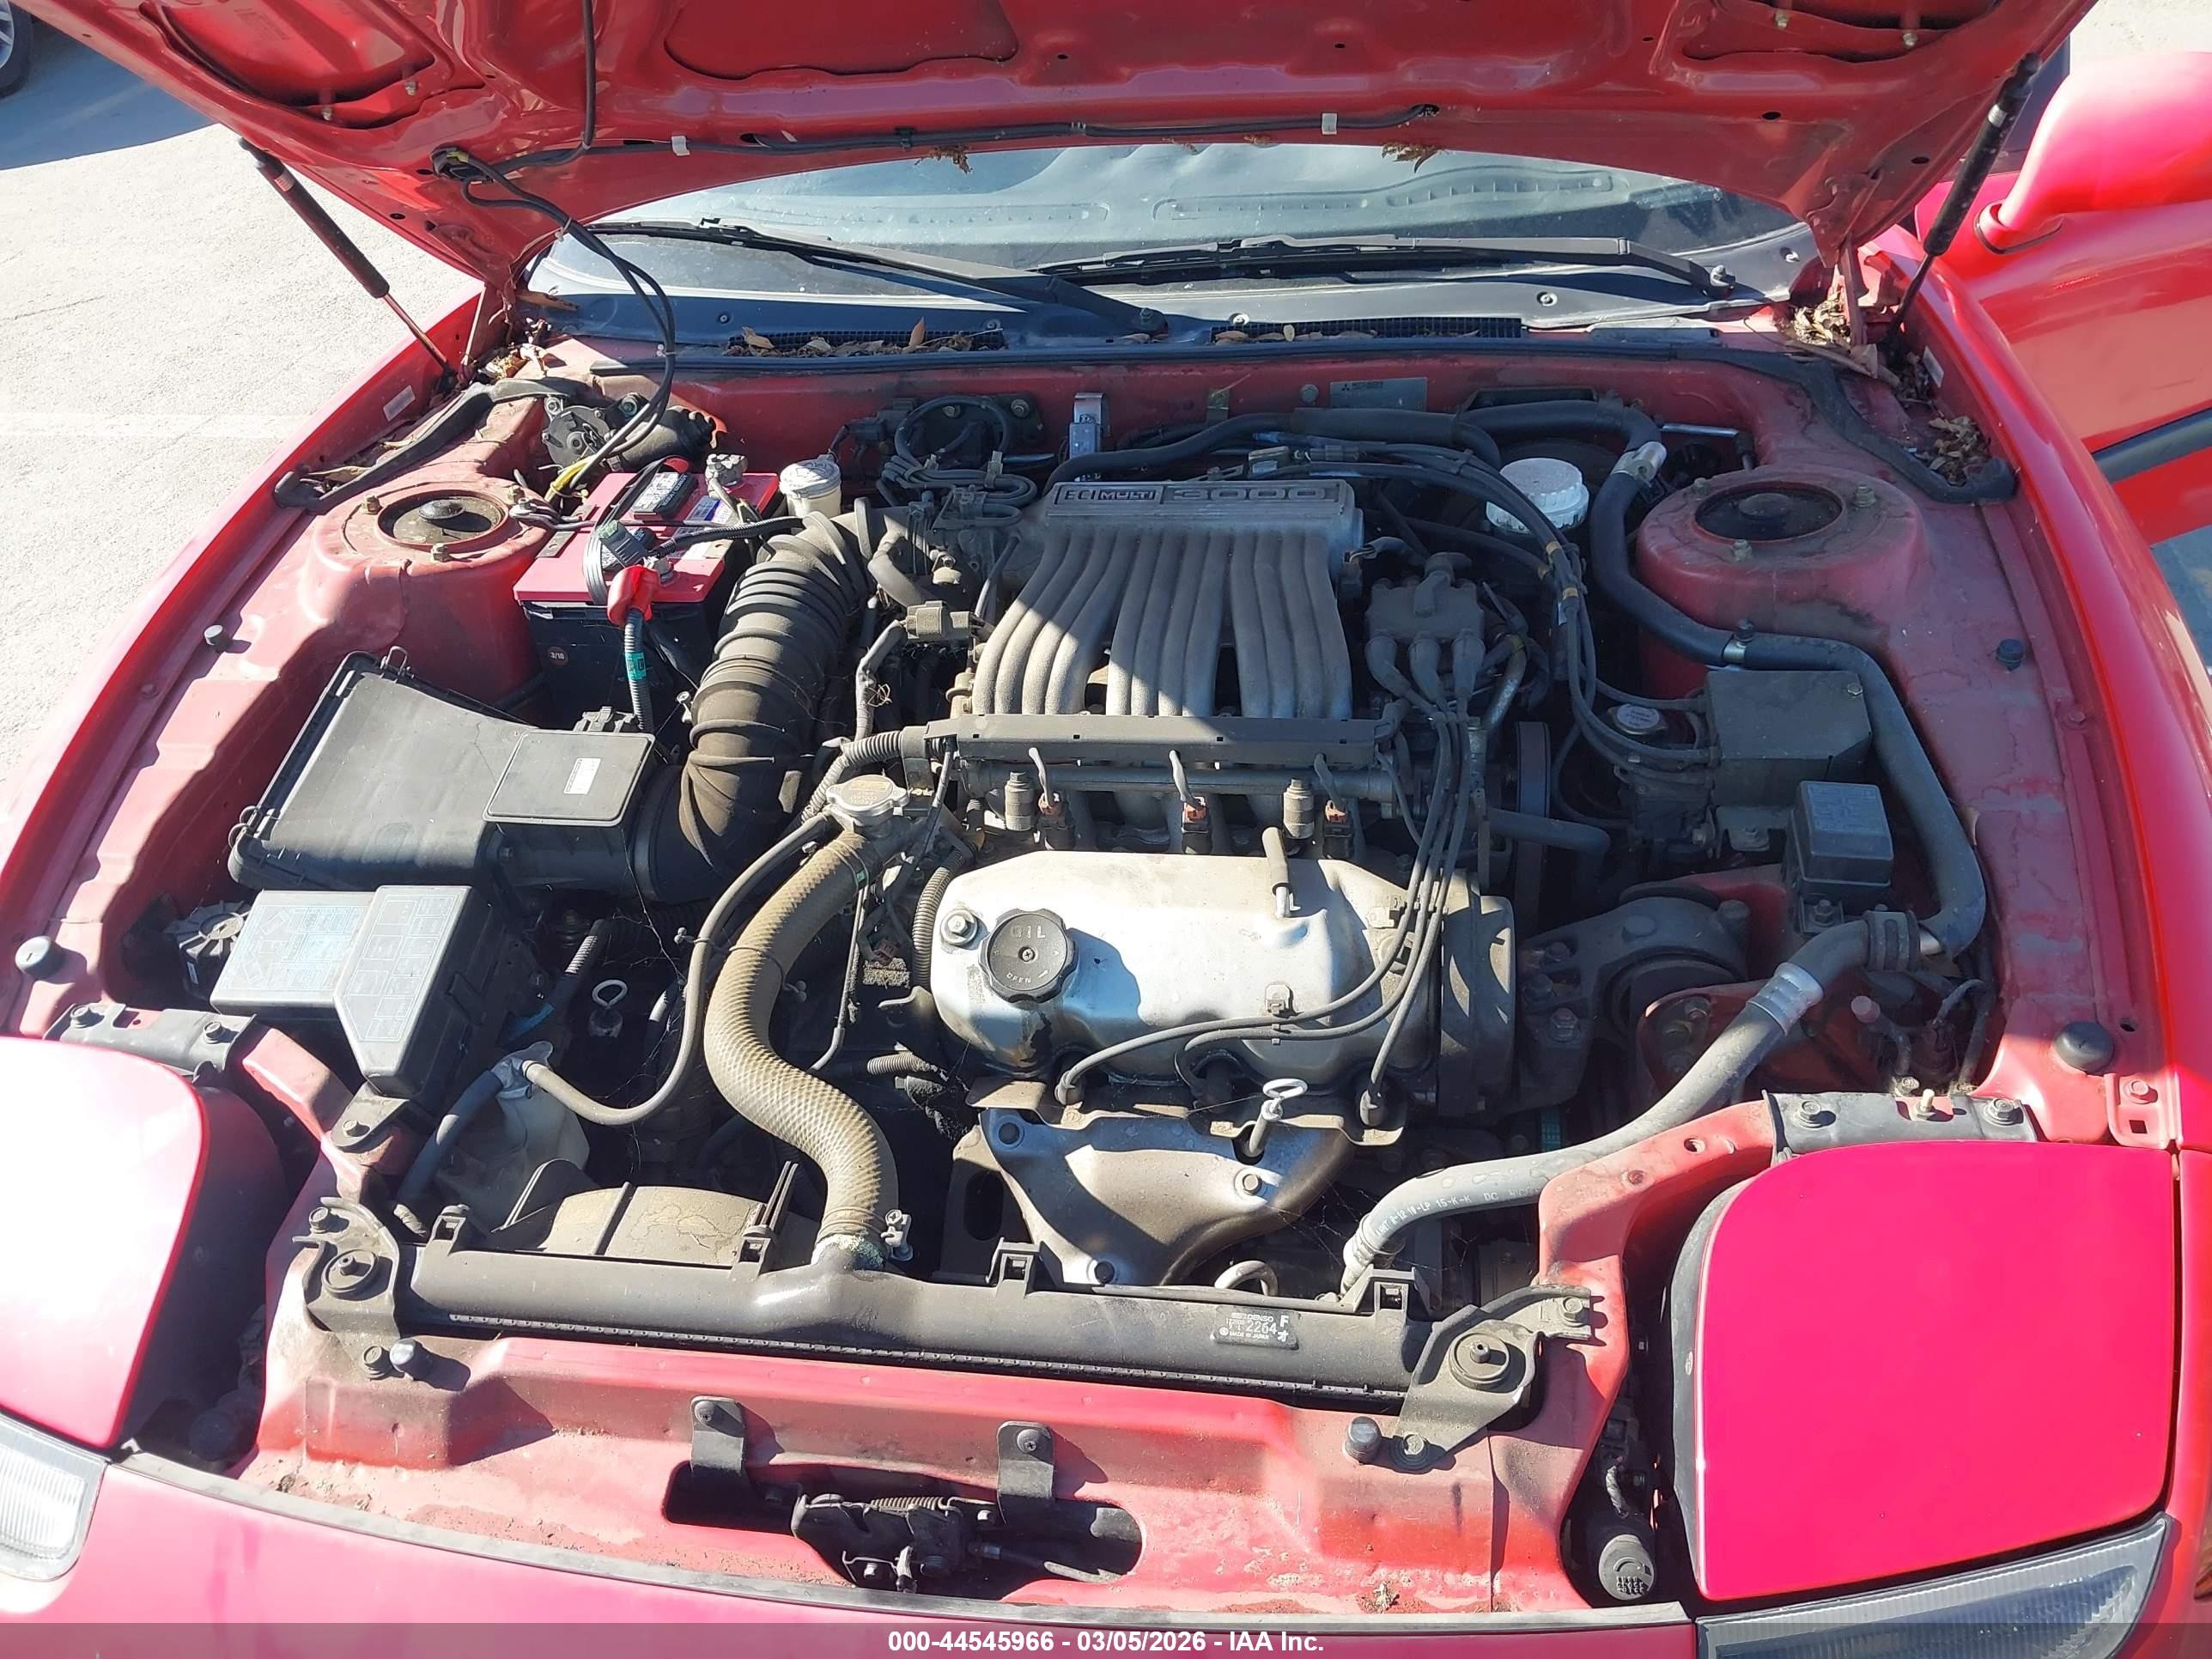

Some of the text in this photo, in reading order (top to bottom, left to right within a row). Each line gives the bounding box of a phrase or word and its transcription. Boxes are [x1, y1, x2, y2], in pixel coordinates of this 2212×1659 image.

[1064, 487, 1326, 501] ECI MULTI 3000
[550, 652, 565, 660] 3/10
[1010, 925, 1046, 939] OIL
[1006, 970, 1031, 983] OPEN
[1245, 1320, 1278, 1334] 2264
[1279, 1315, 1290, 1328] F
